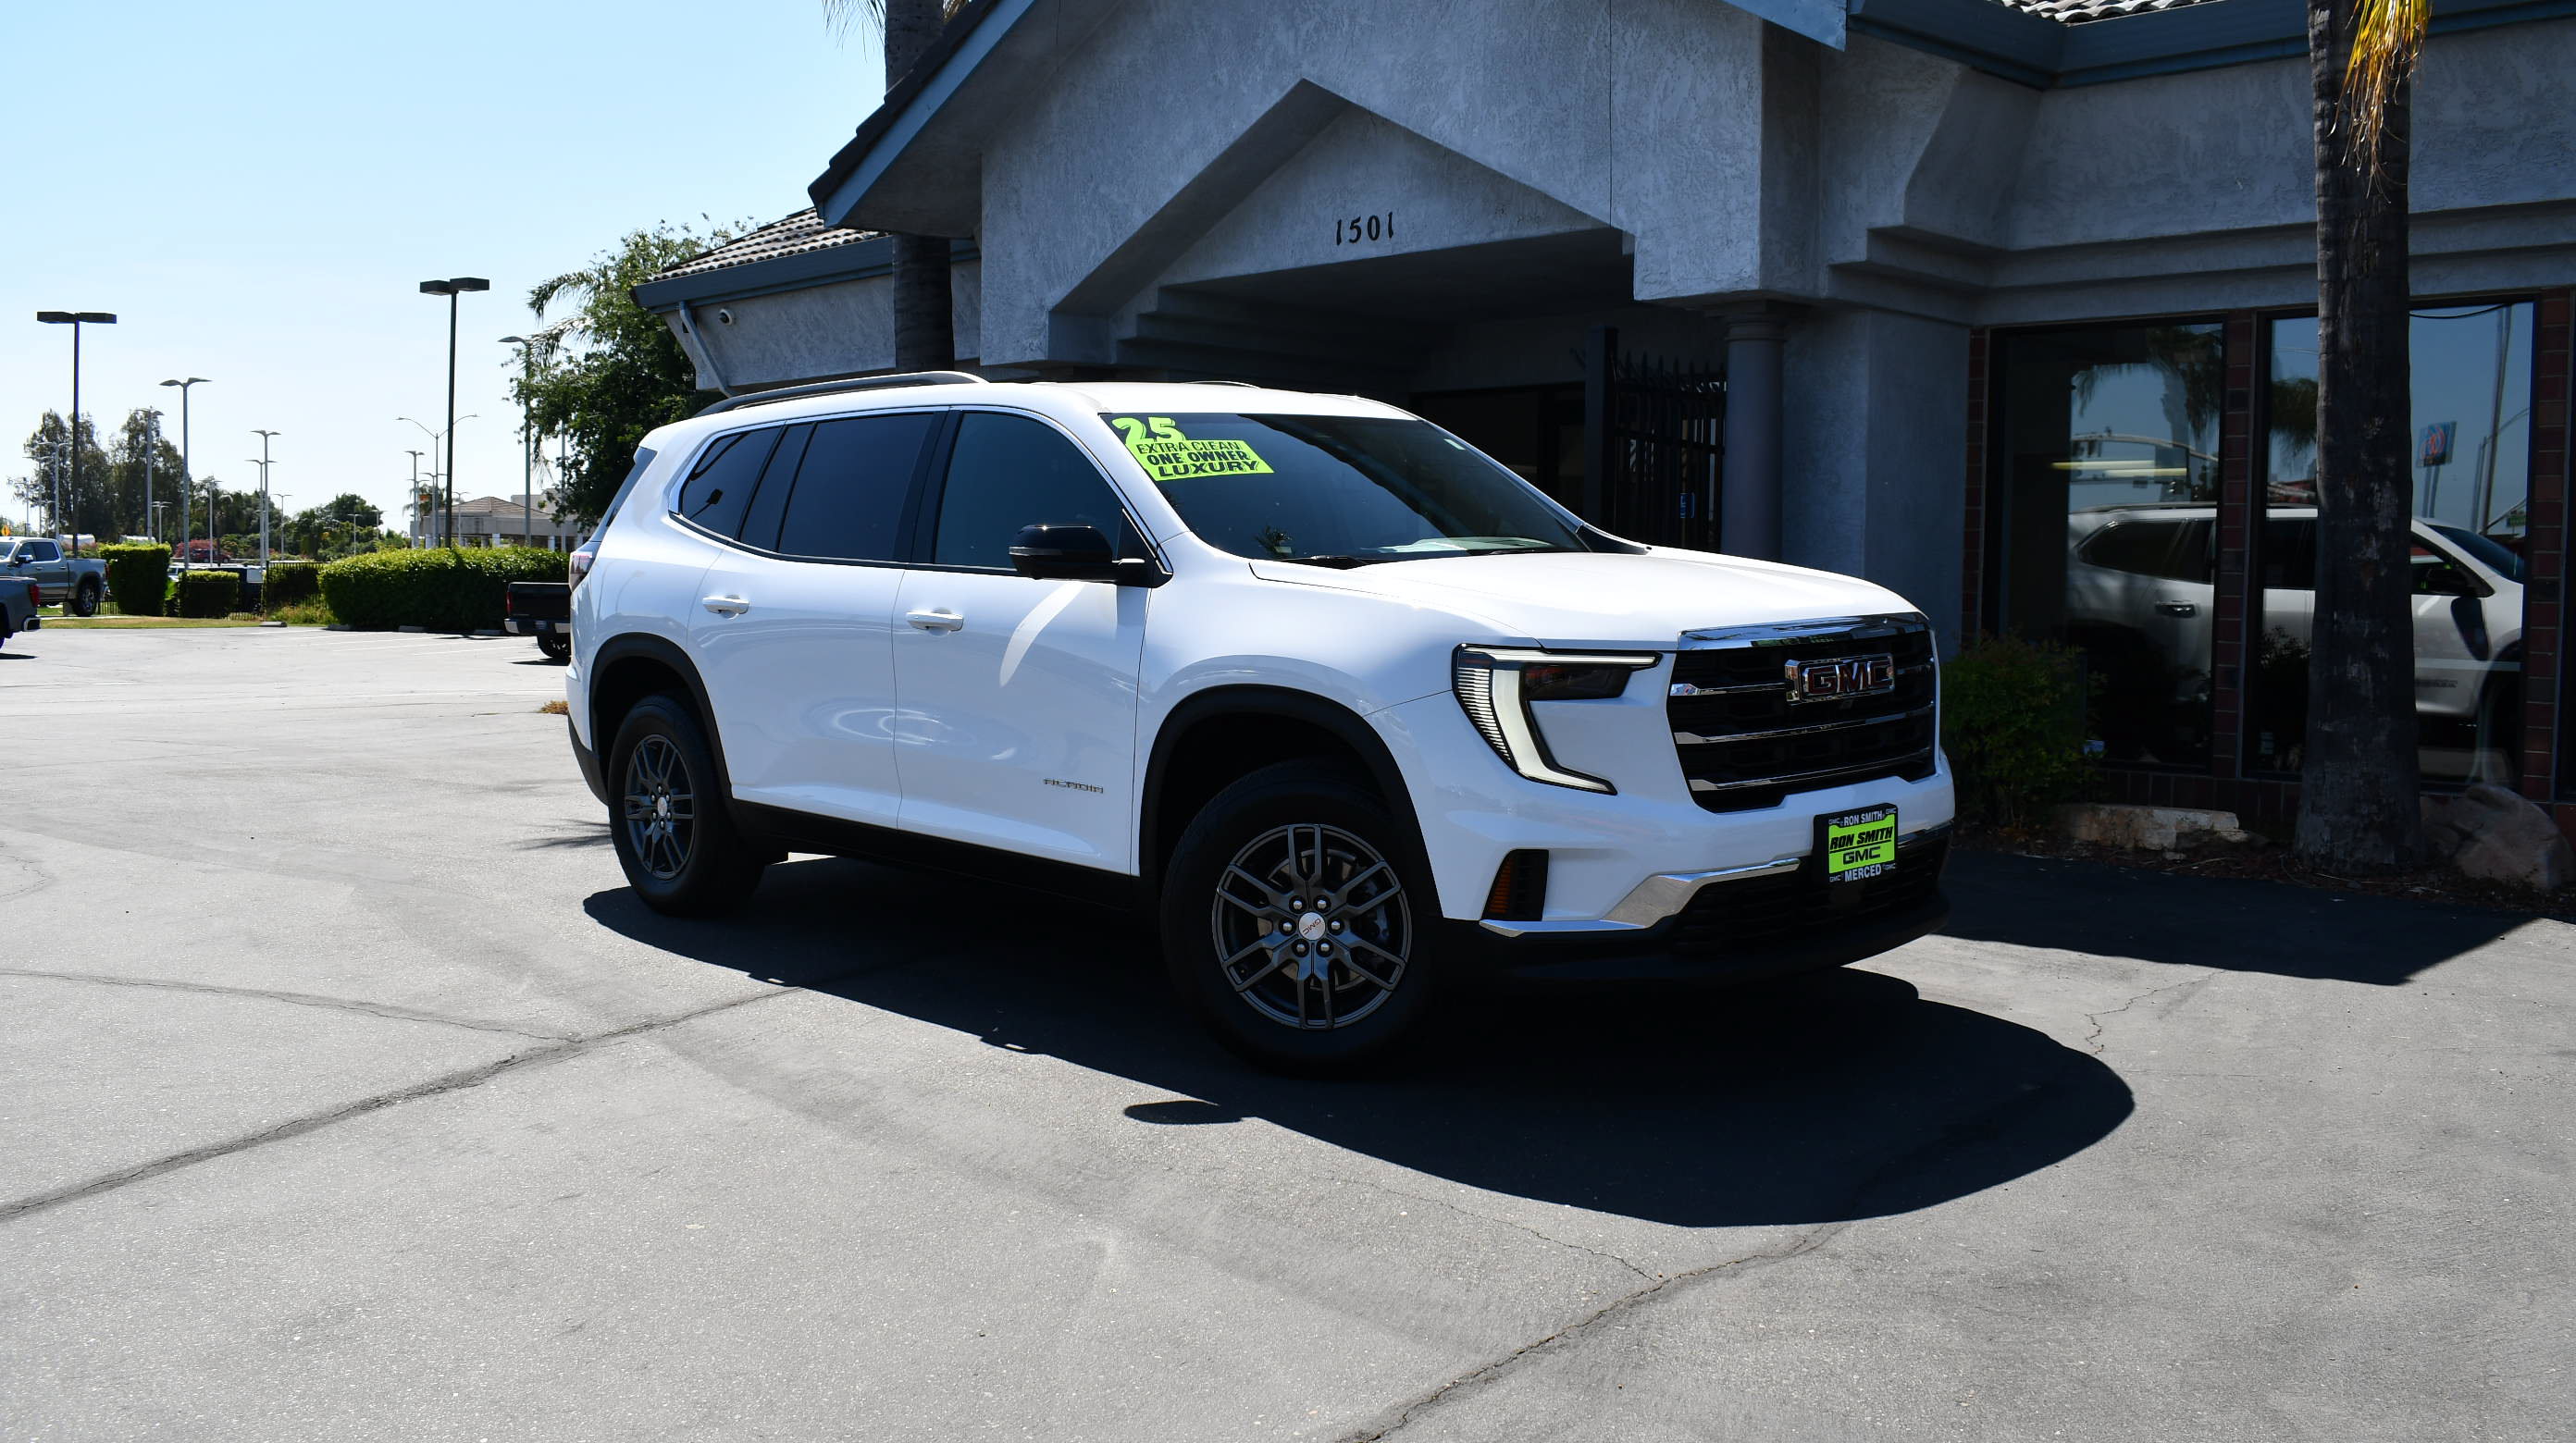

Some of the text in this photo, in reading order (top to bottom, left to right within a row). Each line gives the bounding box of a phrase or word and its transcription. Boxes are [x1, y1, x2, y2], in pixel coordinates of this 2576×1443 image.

[1336, 211, 1393, 246] 1501
[1111, 416, 1186, 444] 25
[1136, 440, 1241, 454] EXTRA CLEAN
[1146, 450, 1251, 465] ONE OWNER
[1158, 460, 1259, 477] LUXURY
[1802, 657, 1895, 697] GMC
[1844, 815, 1860, 826] RON
[1861, 810, 1882, 823] SMITH
[1829, 826, 1894, 850] RON SMITH
[1843, 846, 1880, 864] GMC
[1845, 864, 1881, 882] MERCED
[1302, 918, 1321, 935] GMC
